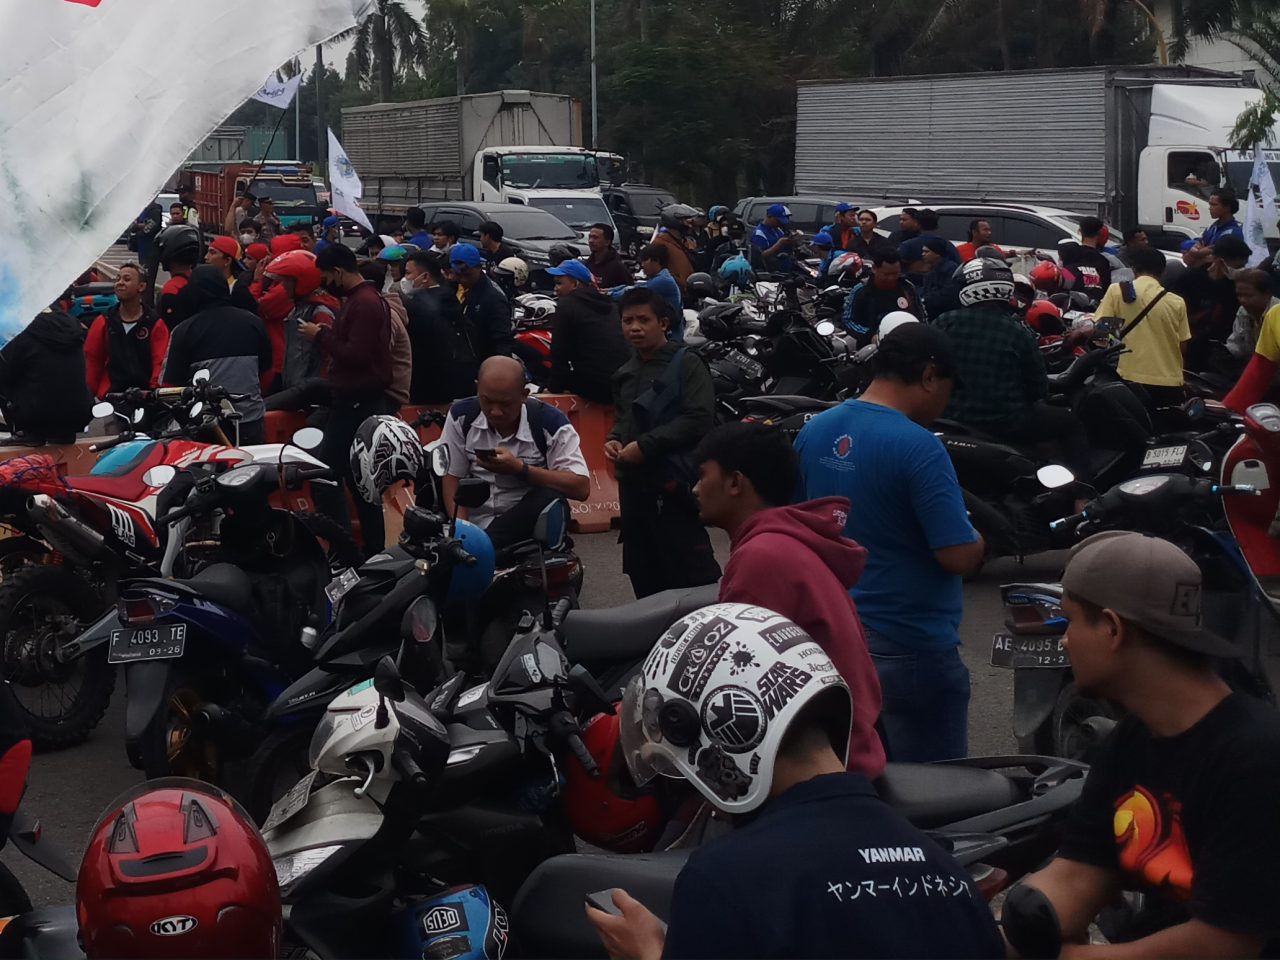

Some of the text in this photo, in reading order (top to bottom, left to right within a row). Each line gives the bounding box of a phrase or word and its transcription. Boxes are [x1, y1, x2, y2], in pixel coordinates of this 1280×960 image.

[112, 627, 184, 645] F 4093 TE
[995, 637, 1013, 651] AE
[1020, 639, 1052, 652] 4095
[756, 661, 793, 699] STAR
[761, 667, 813, 722] WARS
[858, 847, 926, 864] YANMAR
[153, 917, 196, 935] KYT
[426, 909, 457, 932] DEUS
